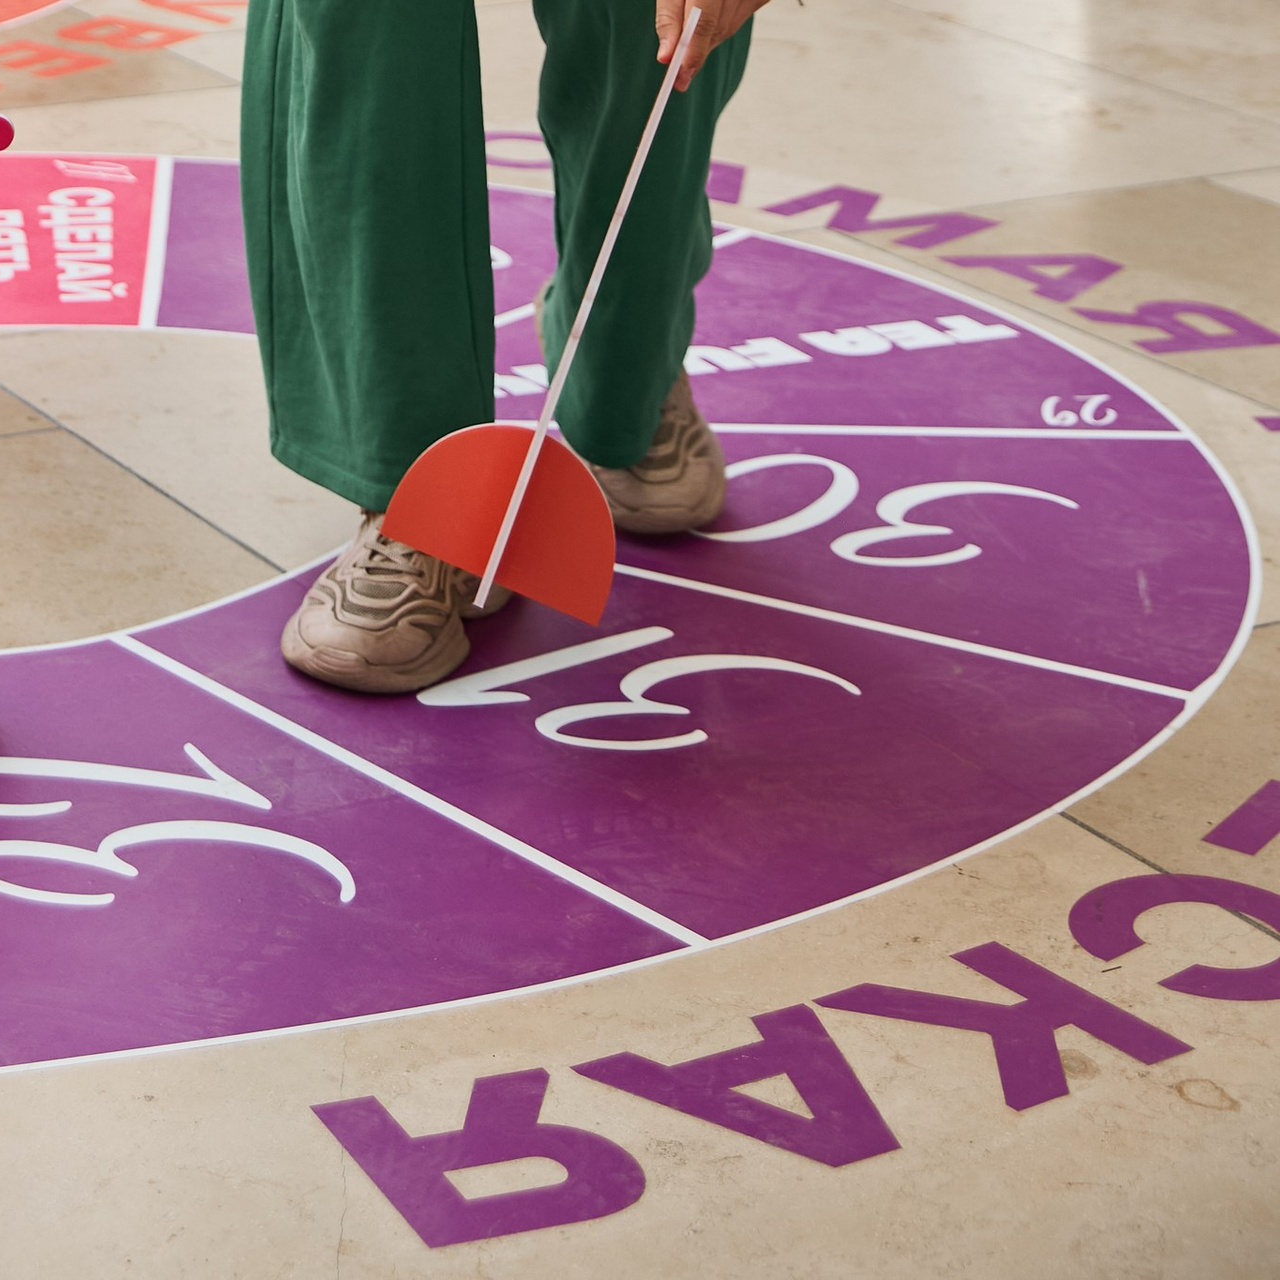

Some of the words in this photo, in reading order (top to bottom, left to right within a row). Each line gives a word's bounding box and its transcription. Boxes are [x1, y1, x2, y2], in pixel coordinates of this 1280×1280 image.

[44, 185, 129, 303] СДЕЛАЙ
[800, 314, 1021, 359] TEA
[1040, 394, 1119, 427] 29
[690, 453, 1080, 569] 30
[416, 626, 862, 752] 31
[309, 778, 1280, 1249] СКАЯ
